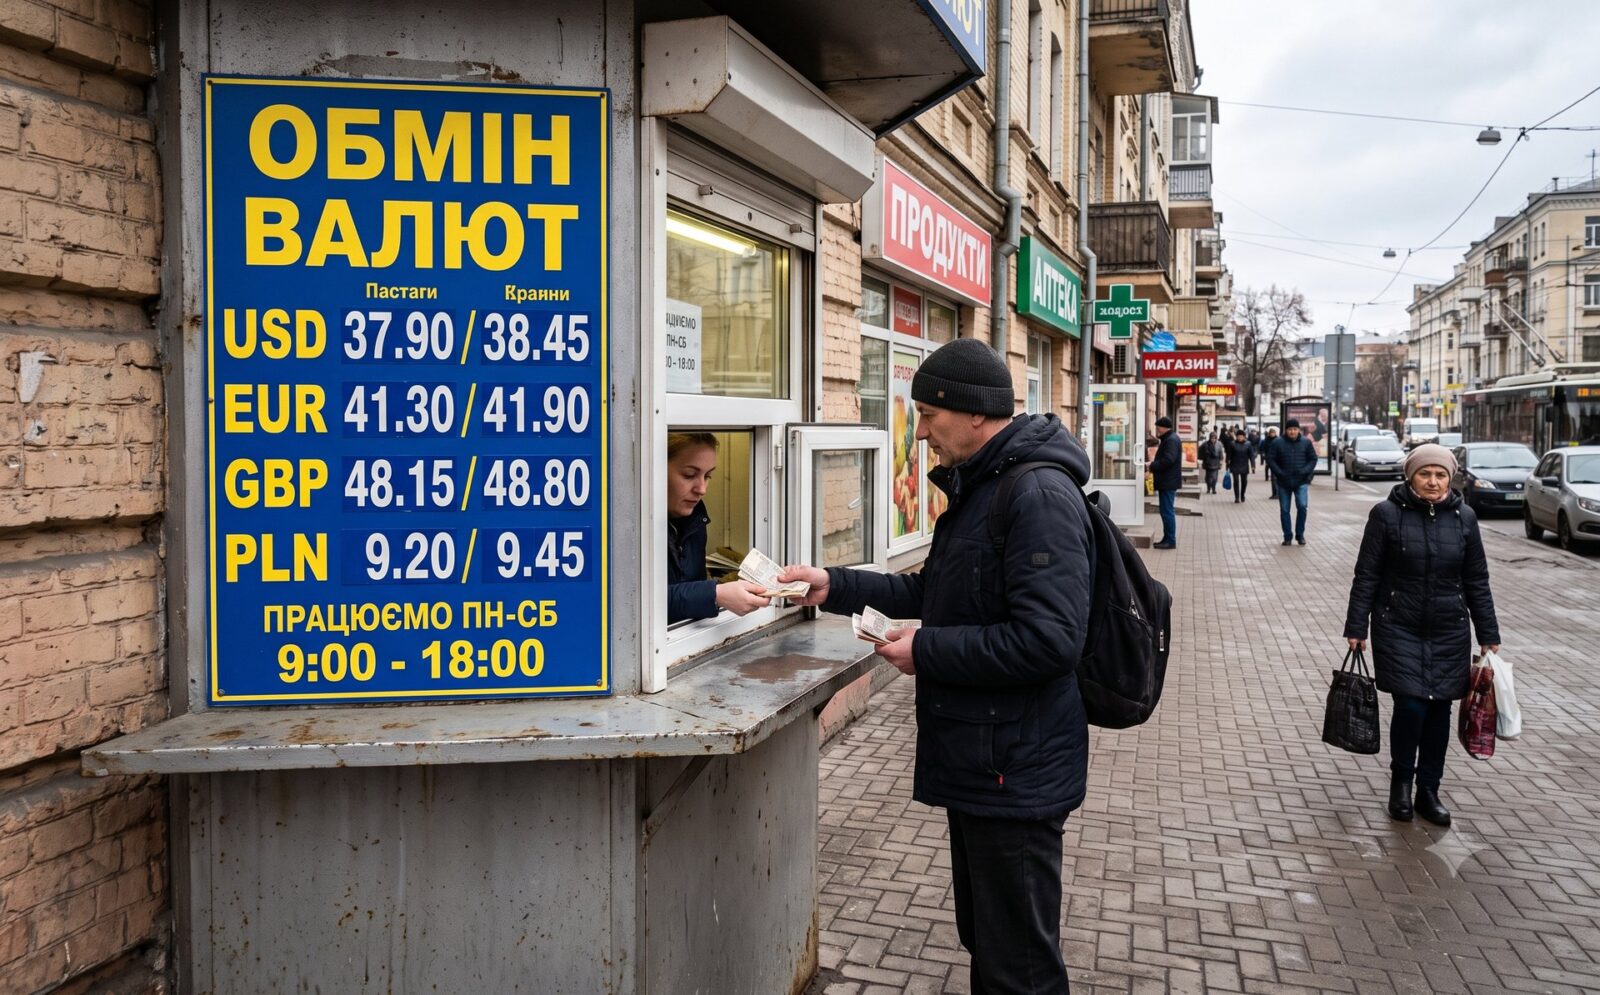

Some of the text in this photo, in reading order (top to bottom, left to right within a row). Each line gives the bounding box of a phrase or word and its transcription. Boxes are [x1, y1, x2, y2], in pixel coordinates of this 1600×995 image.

[249, 104, 570, 185] ОБМІН
[245, 197, 579, 271] ВАЛЮТ
[891, 183, 986, 288] ПРОДУКТИ
[1033, 256, 1078, 326] АПТЕКА
[224, 308, 327, 359] USD
[343, 310, 454, 360] 37.90
[483, 312, 590, 362] 38.45
[678, 357, 696, 370] 18:00
[1144, 358, 1215, 371] МАГАЗИН
[224, 383, 328, 434] EUR
[344, 384, 455, 433] 41.30
[483, 385, 590, 433] 41.90
[224, 458, 328, 509] GBP
[344, 459, 455, 508] 48.15
[483, 458, 590, 507] 48.80
[225, 532, 328, 583] PLN
[365, 532, 455, 581] 9.20
[497, 531, 585, 579] 9.45
[263, 600, 559, 637] ПРАЦЮЄМО ПН-СБ
[277, 642, 377, 683] 9:00
[421, 638, 545, 680] 18:00
